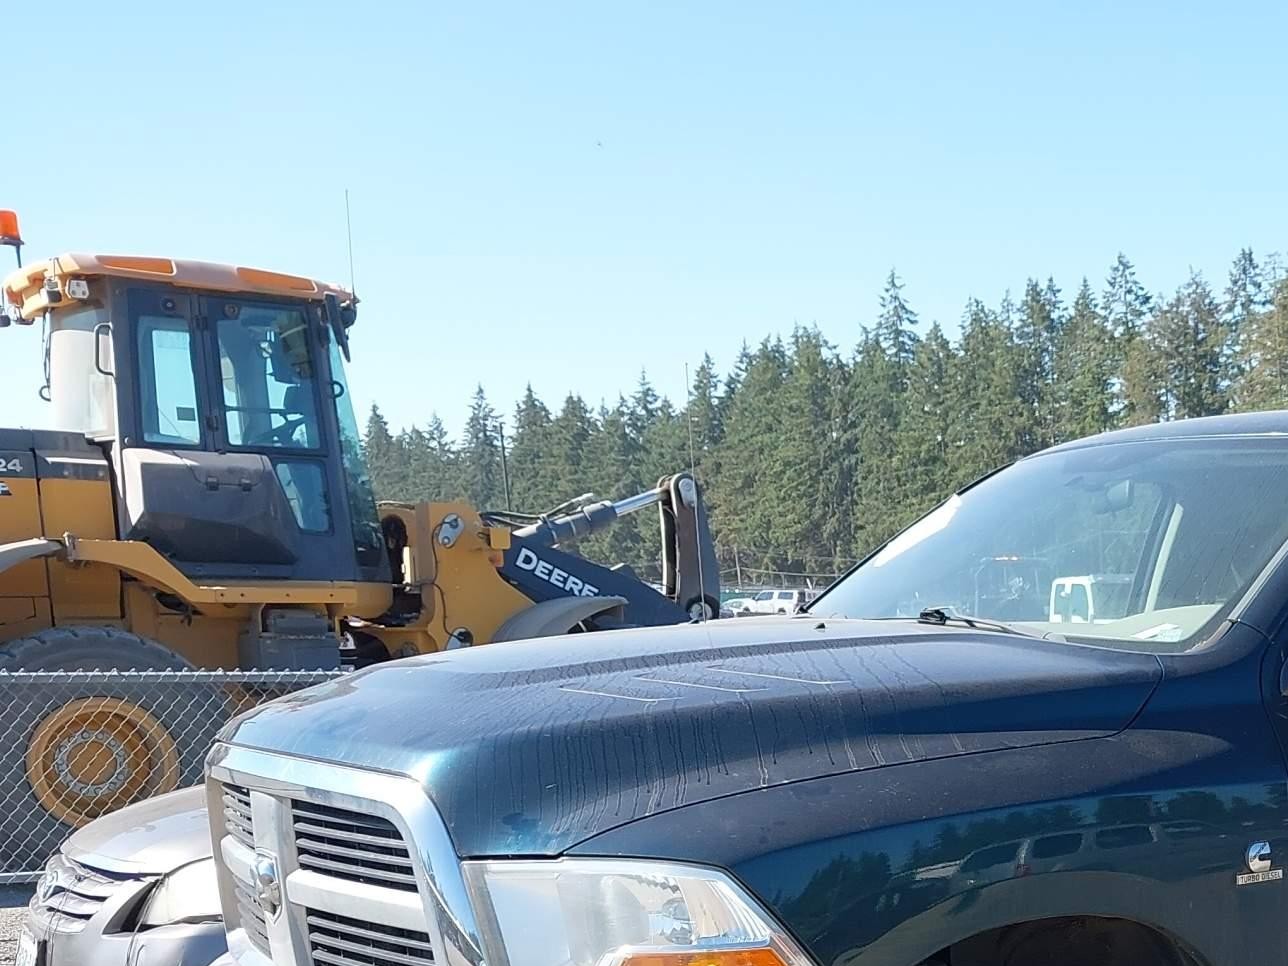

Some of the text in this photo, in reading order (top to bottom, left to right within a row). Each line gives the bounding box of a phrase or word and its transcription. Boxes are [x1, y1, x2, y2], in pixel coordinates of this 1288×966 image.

[515, 547, 600, 598] DEERE
[1239, 870, 1281, 884] TURBO DIESEL
